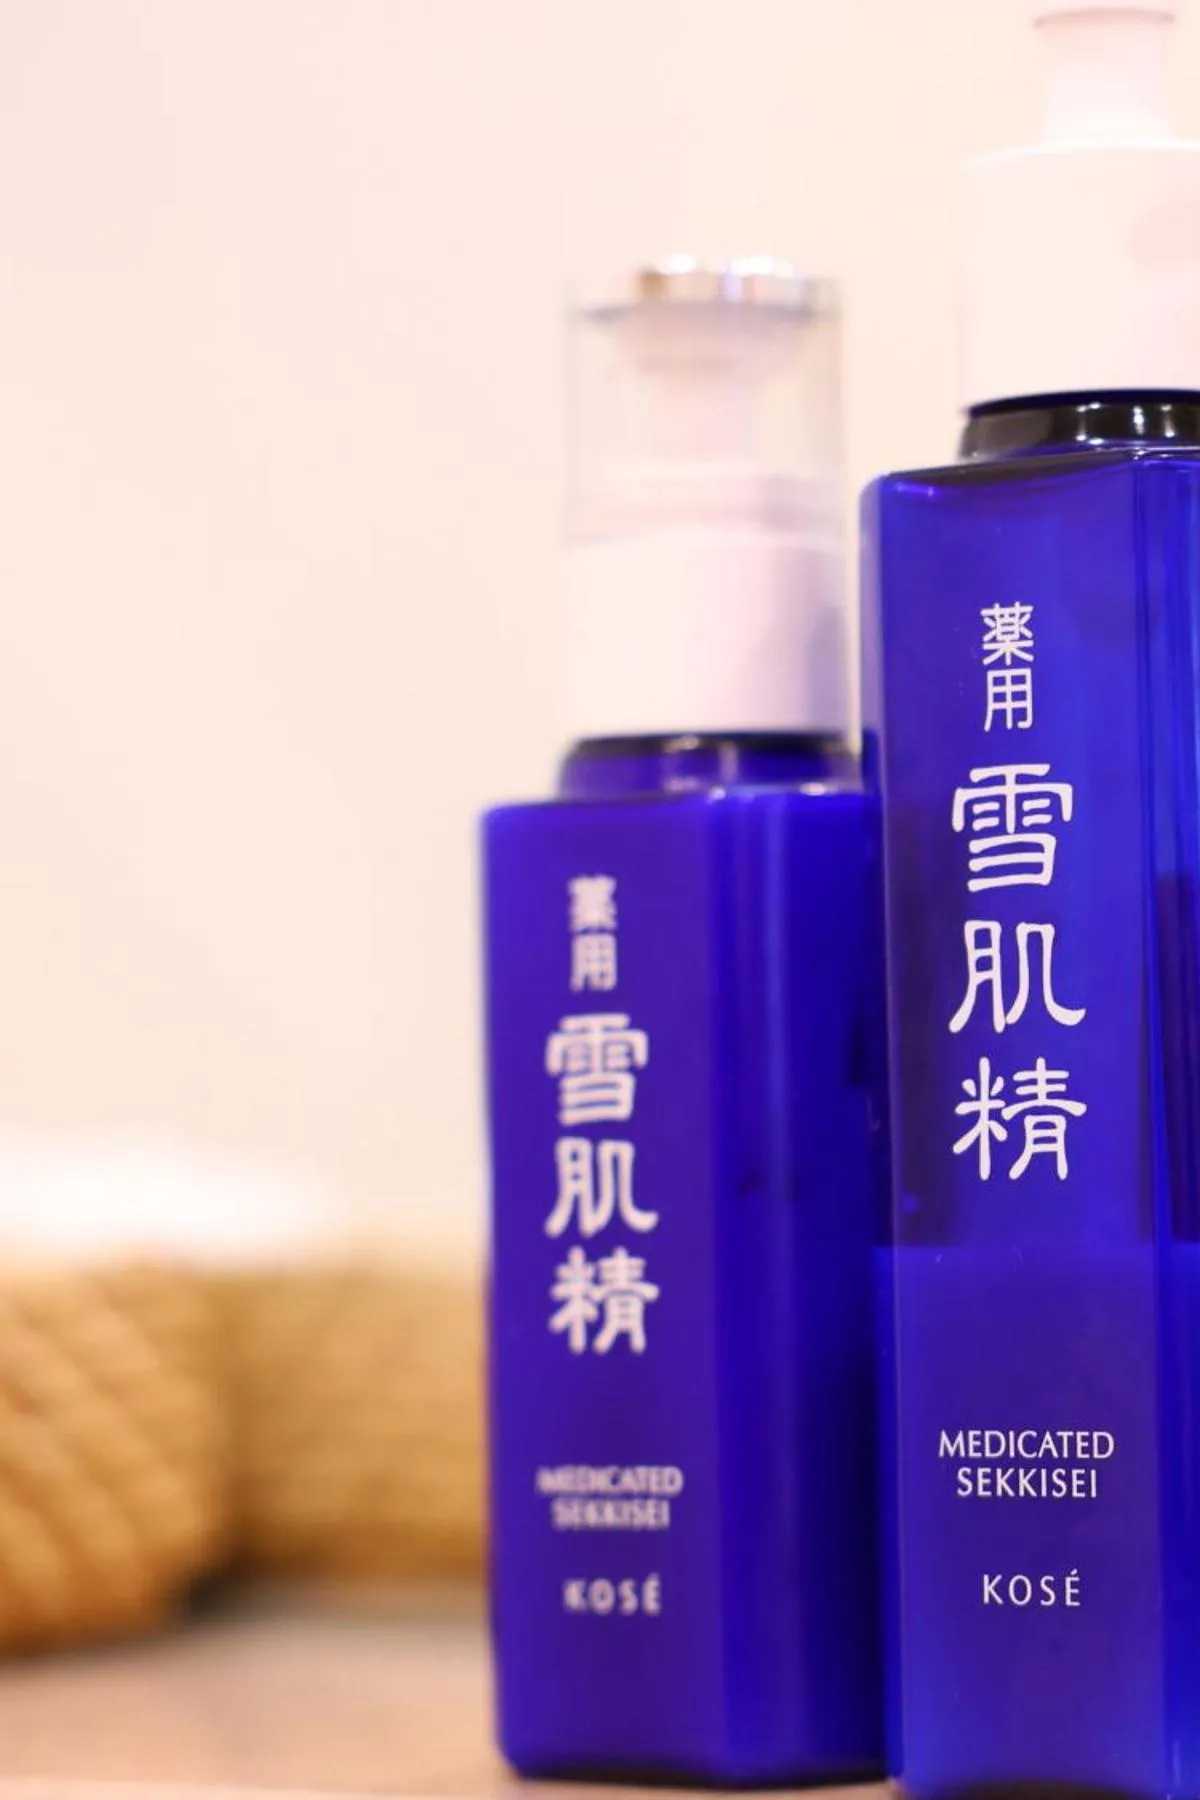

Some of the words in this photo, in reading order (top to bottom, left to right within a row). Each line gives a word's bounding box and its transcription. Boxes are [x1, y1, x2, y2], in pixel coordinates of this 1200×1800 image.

[980, 601, 1034, 732] 薬用
[948, 763, 1087, 1181] 雪肌精
[546, 1013, 659, 1352] 雪肌精
[938, 1430, 1115, 1459] MEDICATED
[957, 1466, 1097, 1498] SEKKISEI
[564, 1574, 660, 1614] KOSÉ
[983, 1568, 1080, 1607] KOSÉ
